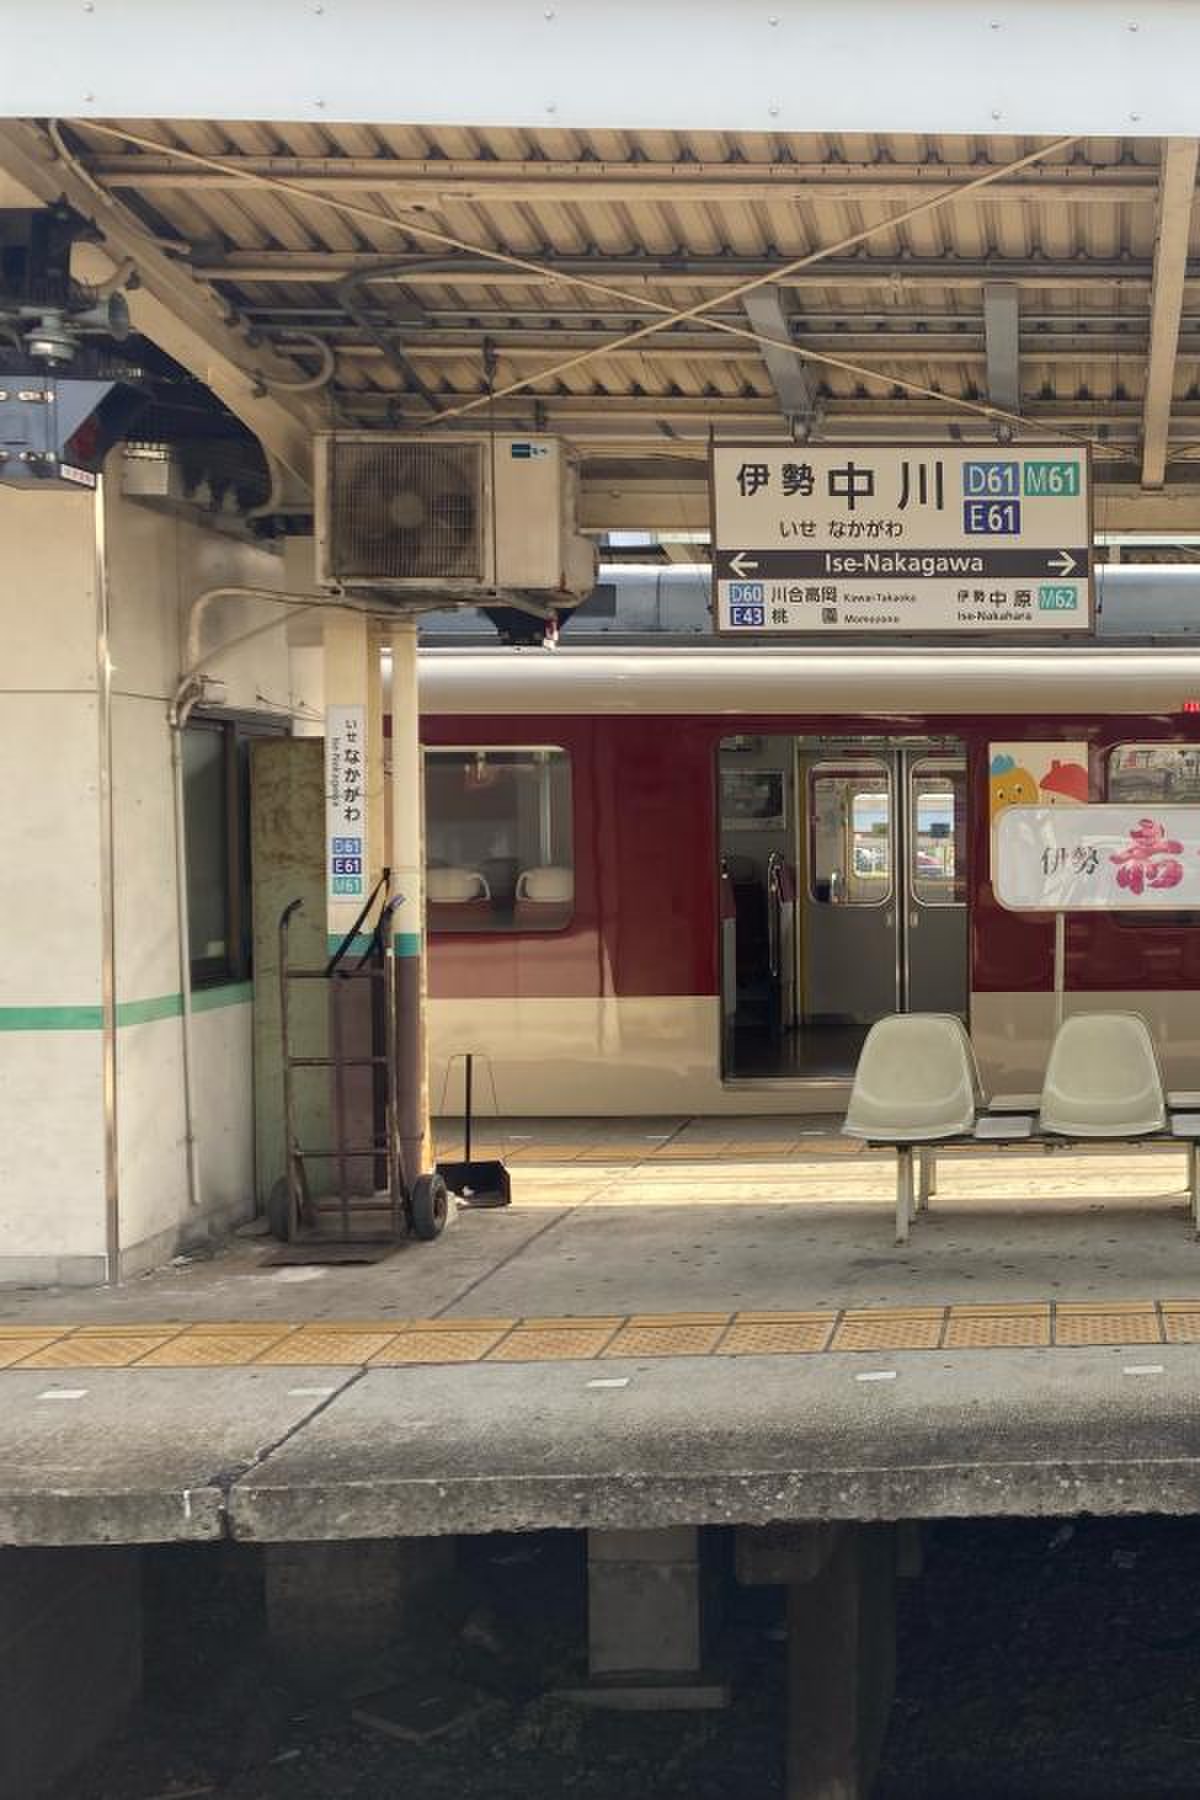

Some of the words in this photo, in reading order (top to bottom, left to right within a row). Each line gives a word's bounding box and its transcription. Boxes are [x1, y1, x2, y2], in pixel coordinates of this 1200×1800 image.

[736, 461, 945, 511] 伊勢中川
[968, 464, 1015, 493] D61
[1026, 464, 1077, 493] M61
[970, 503, 1015, 531] E61
[825, 552, 984, 577] Ise-Nakagawa
[732, 584, 763, 602] D60
[771, 586, 837, 604] 川合高岡
[1040, 588, 1075, 608] M62
[733, 606, 763, 625] E43
[335, 858, 360, 873] E61
[1040, 845, 1100, 876] 伊勢
